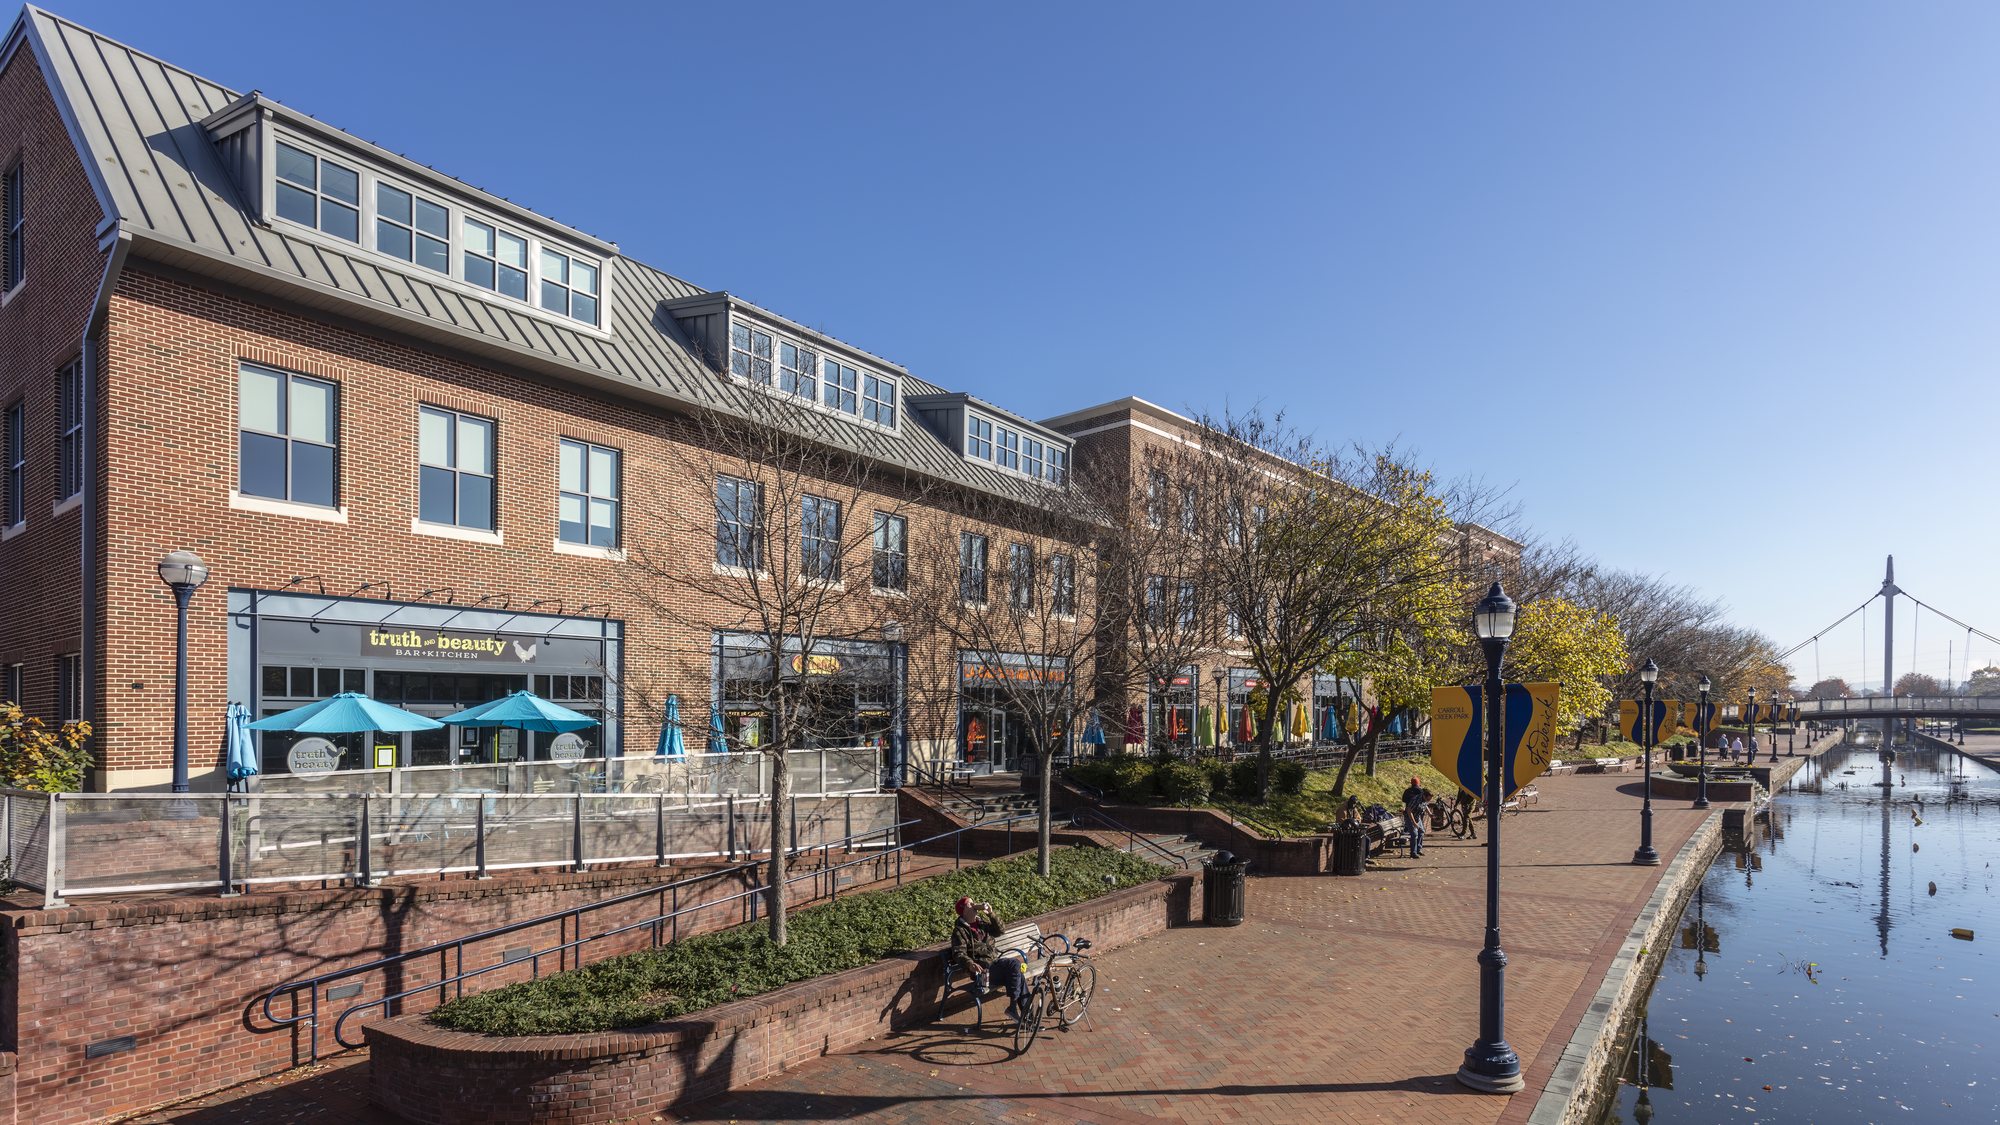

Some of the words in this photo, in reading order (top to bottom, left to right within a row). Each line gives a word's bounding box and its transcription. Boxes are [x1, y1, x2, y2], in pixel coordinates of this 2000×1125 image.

[370, 629, 421, 648] truth
[437, 632, 506, 656] beauty
[1526, 695, 1554, 767] Frederick
[295, 749, 326, 758] truth
[294, 761, 335, 769] beauty
